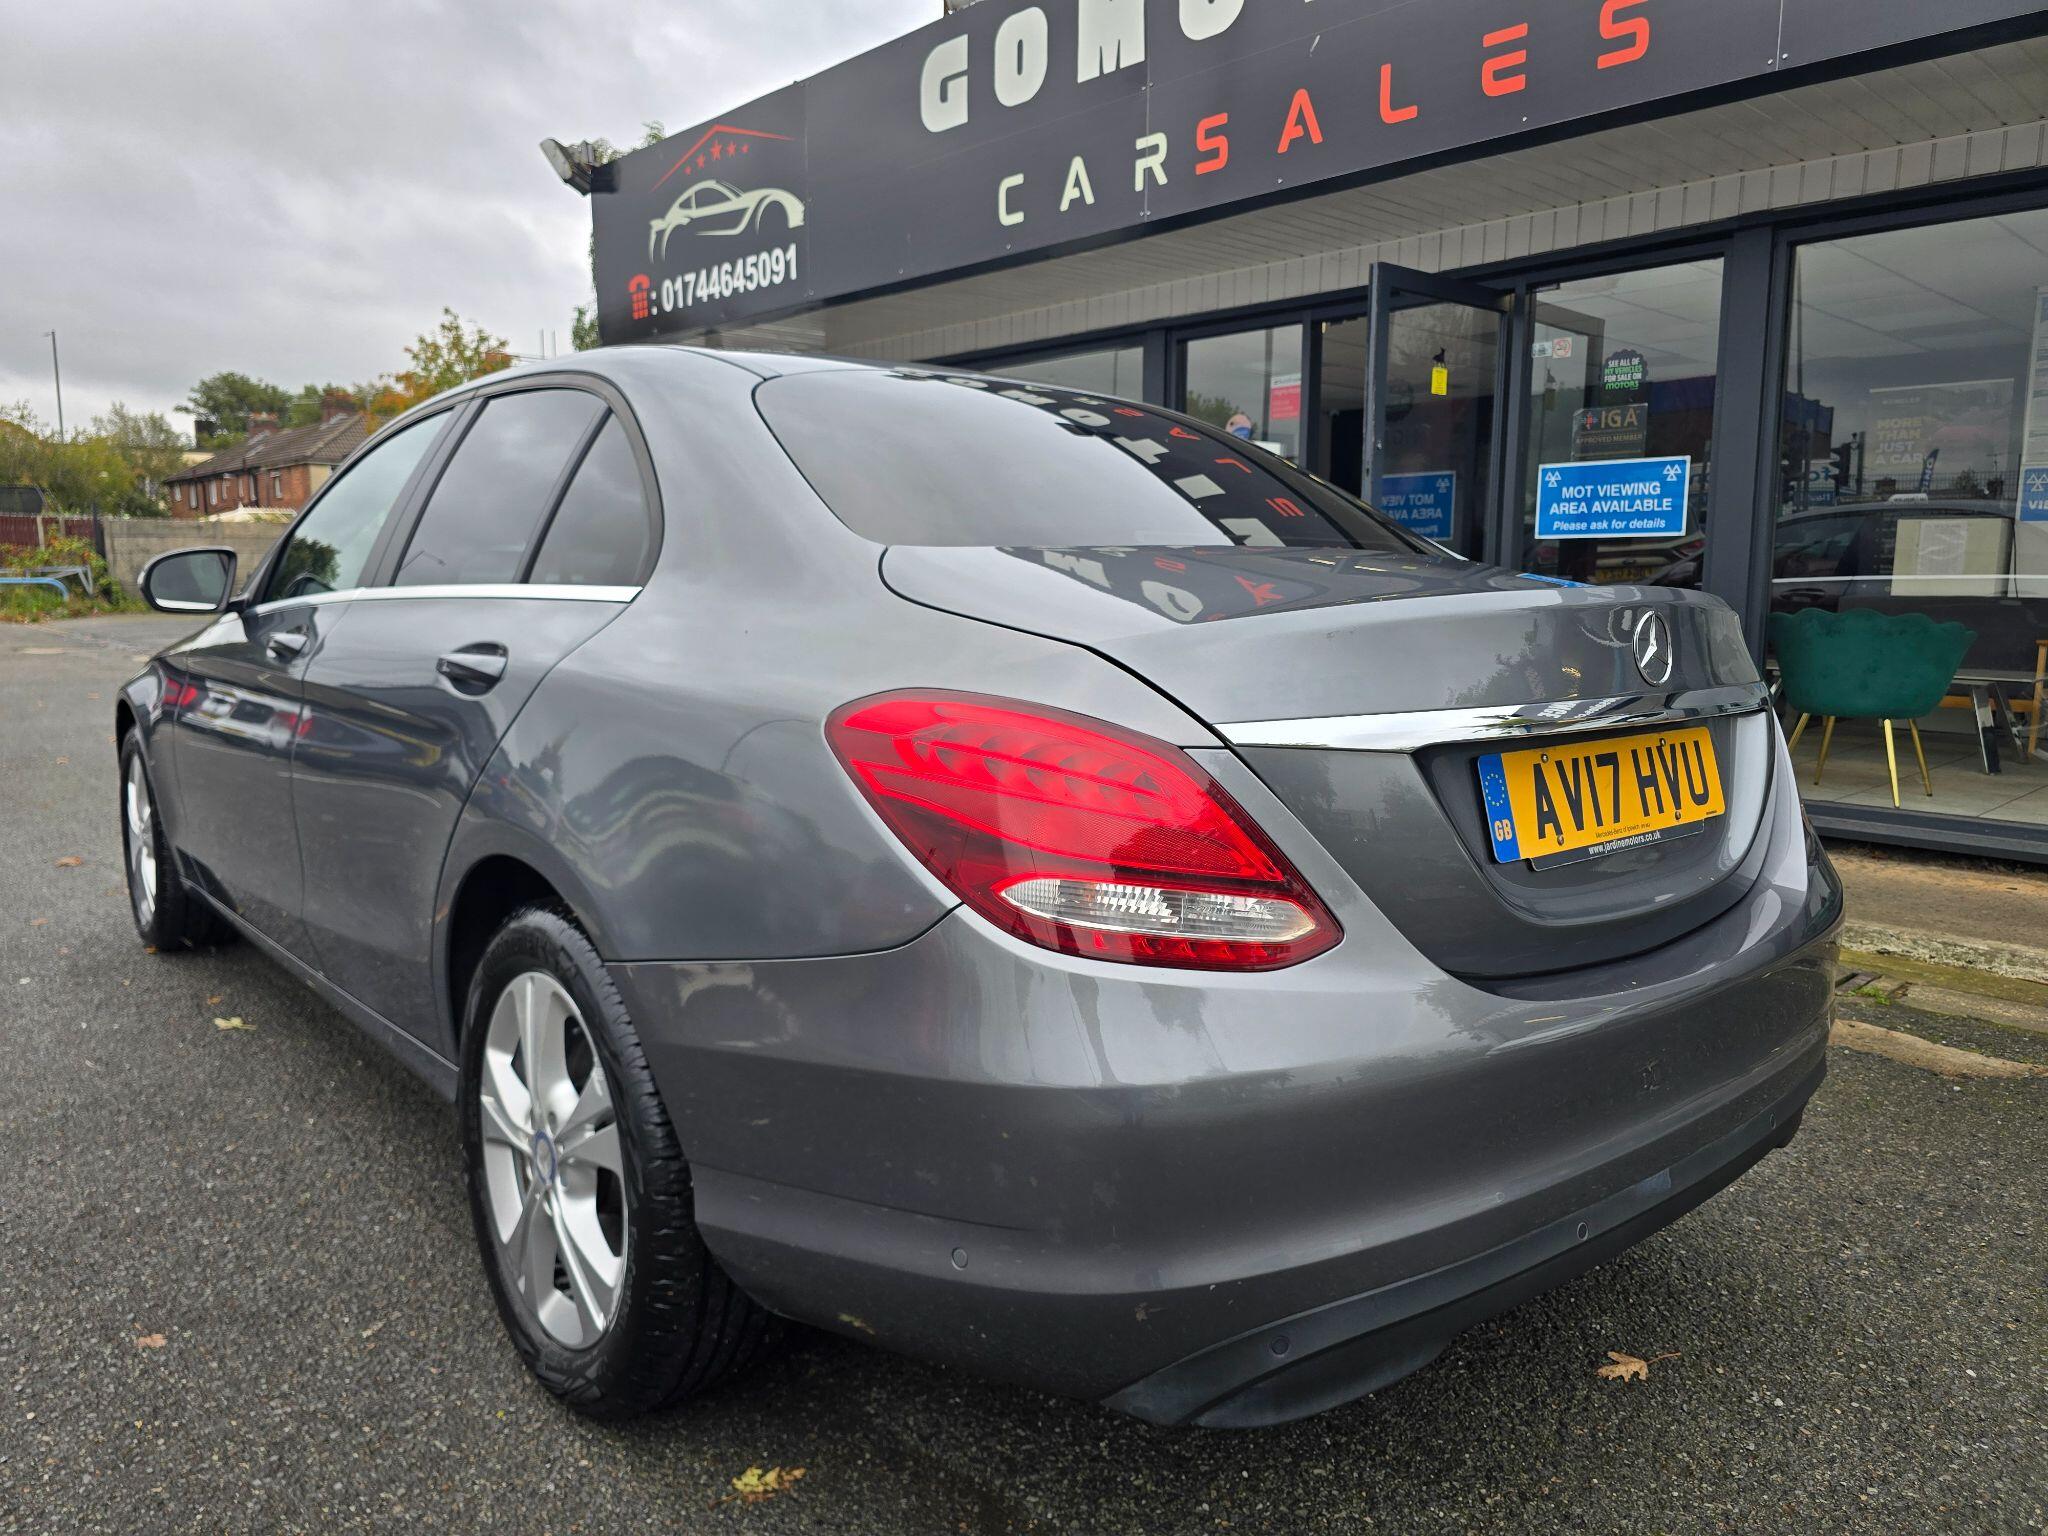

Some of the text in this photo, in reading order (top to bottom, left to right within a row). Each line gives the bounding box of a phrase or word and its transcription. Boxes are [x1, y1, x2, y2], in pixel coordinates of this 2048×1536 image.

[1600, 407, 1638, 428] IGA
[1877, 416, 1922, 429] MORE
[1877, 429, 1920, 441] THAN
[1876, 441, 1914, 453] JUST
[1875, 453, 1924, 465] A CAR
[1562, 482, 1661, 499] MOT VIEWING
[1550, 498, 1672, 515] AREA AVAILABLE
[1553, 517, 1666, 531] Please ask for details
[1533, 740, 1709, 840] AV17 HVU
[1494, 819, 1512, 842] GB
